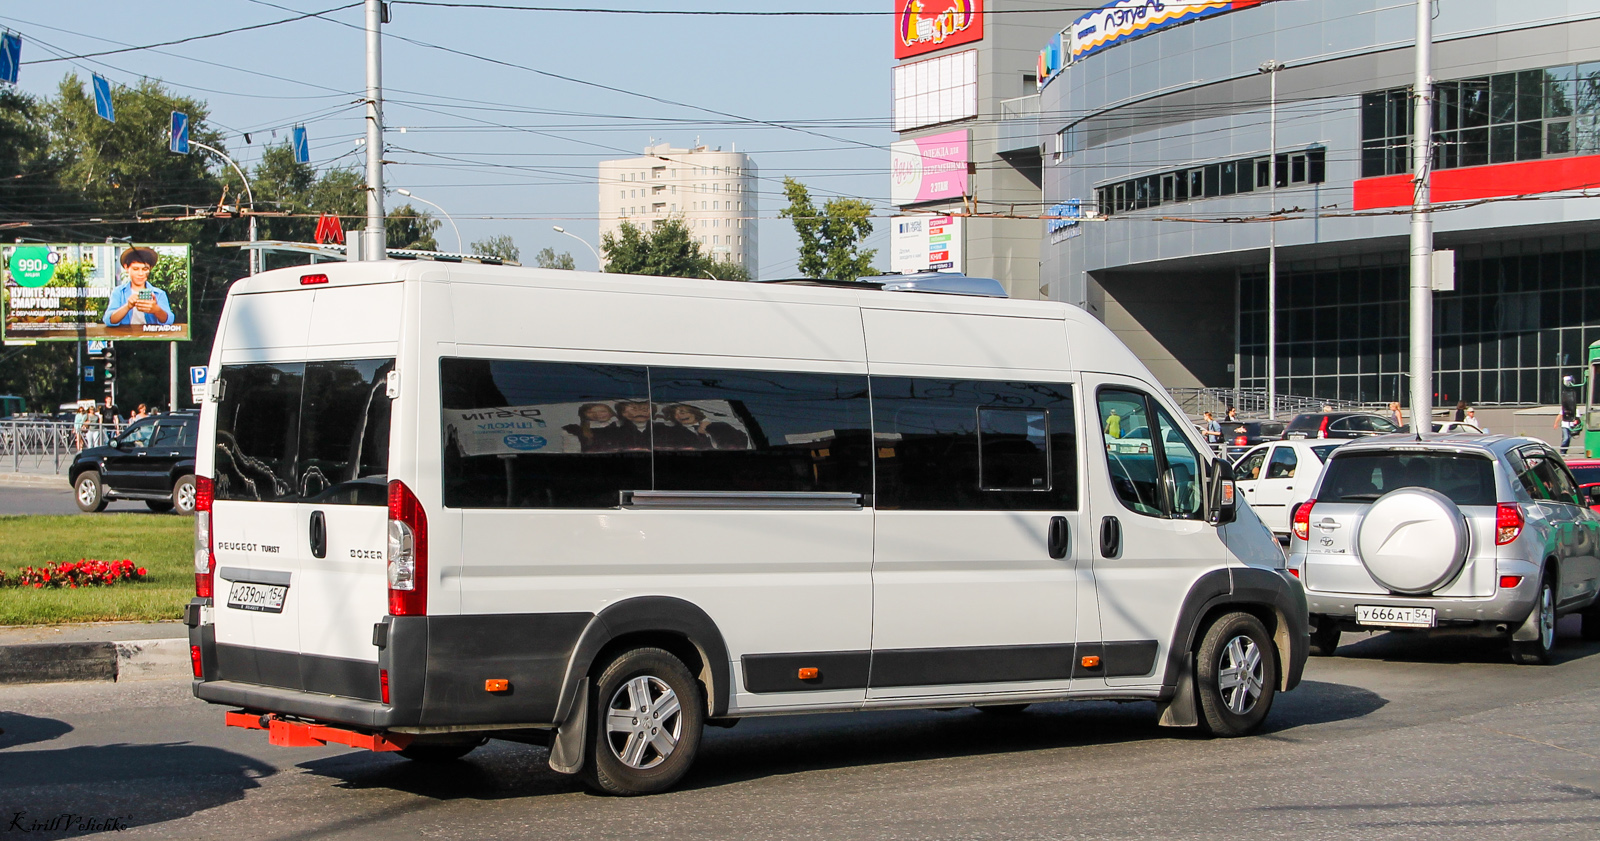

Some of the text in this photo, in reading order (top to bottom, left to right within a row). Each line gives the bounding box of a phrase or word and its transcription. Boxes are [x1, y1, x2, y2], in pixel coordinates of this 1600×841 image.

[930, 182, 935, 193] 2
[930, 252, 944, 261] КНИГ
[10, 286, 43, 298] КУПИТЕ
[10, 297, 60, 309] СМАРТФОН
[194, 368, 205, 383] P
[218, 542, 280, 554] PEUGEOT TURIST
[350, 549, 383, 560] BOXER
[1415, 609, 1427, 619] 54
